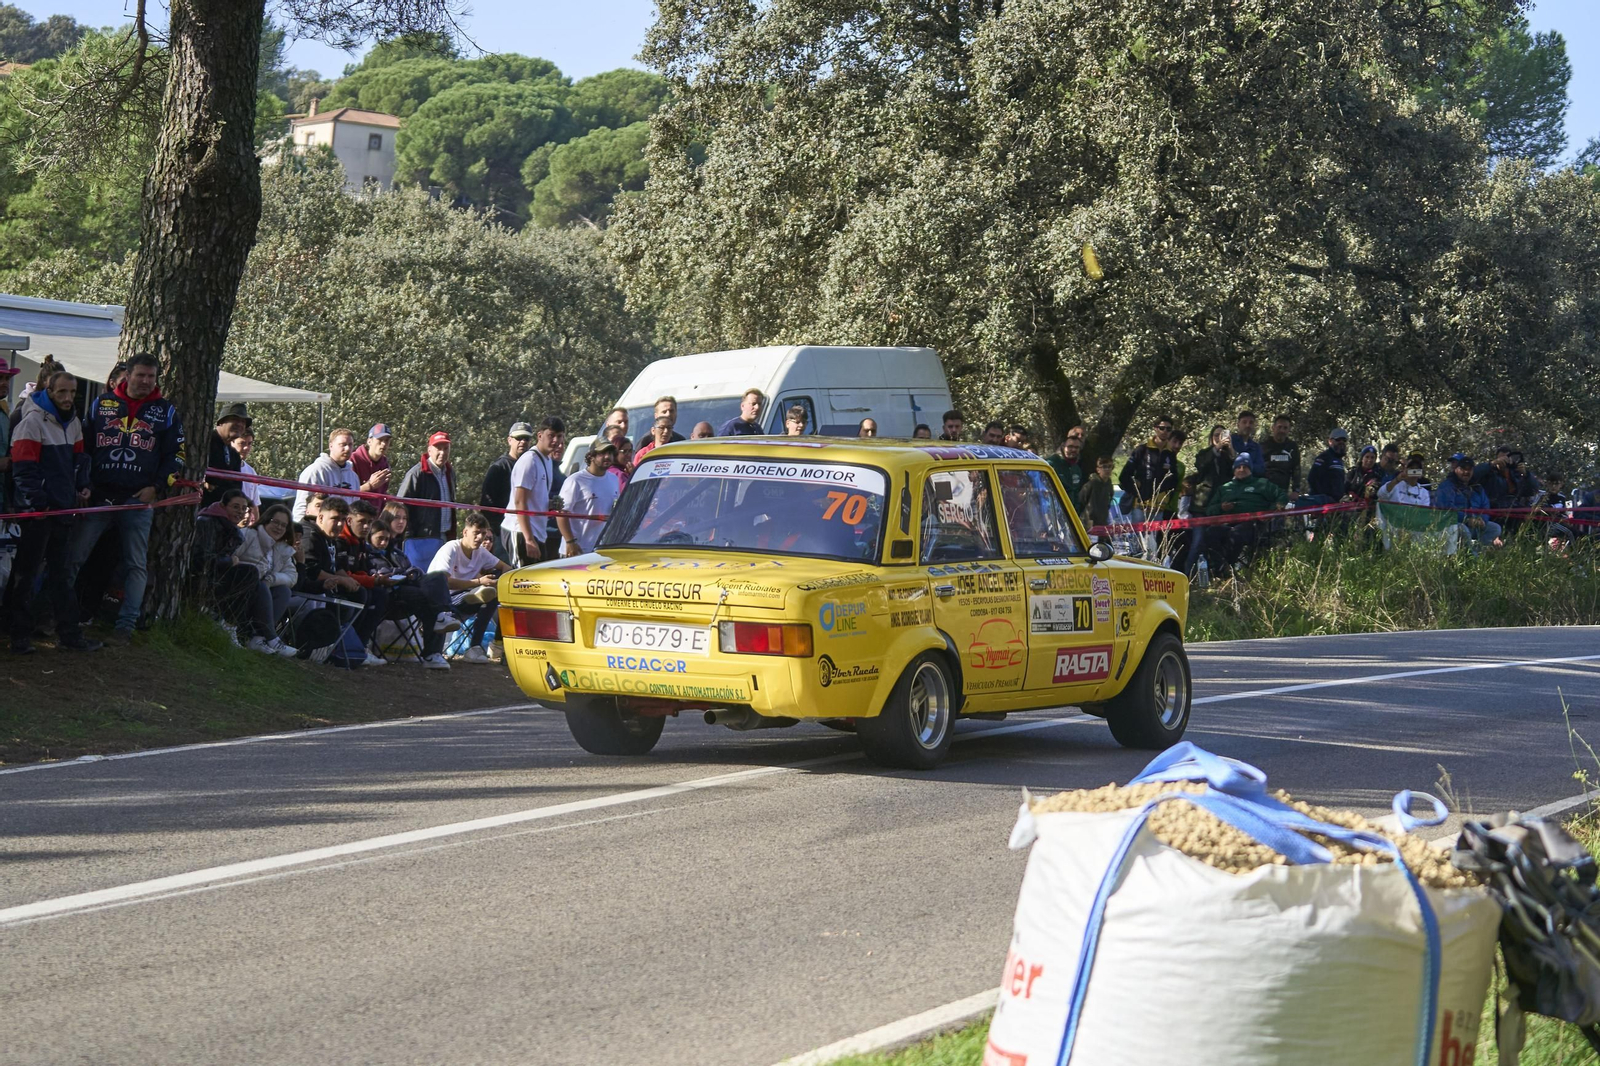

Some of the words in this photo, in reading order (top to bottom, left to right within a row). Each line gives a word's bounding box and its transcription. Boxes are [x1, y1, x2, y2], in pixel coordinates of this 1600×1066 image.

[96, 432, 123, 448] Red
[129, 432, 156, 452] Bull
[680, 463, 729, 474] Talleres
[733, 464, 797, 477] MORENO
[800, 468, 855, 482] MOTOR
[822, 490, 868, 525] 70
[938, 503, 973, 524] SERGIO
[586, 579, 633, 597] GRUPO
[638, 581, 702, 600] SETESUR
[745, 583, 781, 593] Rubiales
[957, 574, 976, 595] JOSE
[978, 572, 1003, 594] ANGEL
[1003, 571, 1019, 592] REY
[1142, 571, 1175, 594] bernier
[835, 602, 866, 617] DEPUR
[1075, 600, 1090, 628] 70
[836, 617, 857, 631] LINE
[607, 655, 687, 673] RECACOR
[832, 667, 852, 679] Iber
[852, 665, 879, 676] Rueda
[1054, 651, 1109, 677] RASTA
[649, 683, 676, 697] CONTROL
[677, 685, 682, 697] Y
[682, 685, 734, 700] AUTOMATIZACIÓN
[735, 688, 746, 700] S.L.
